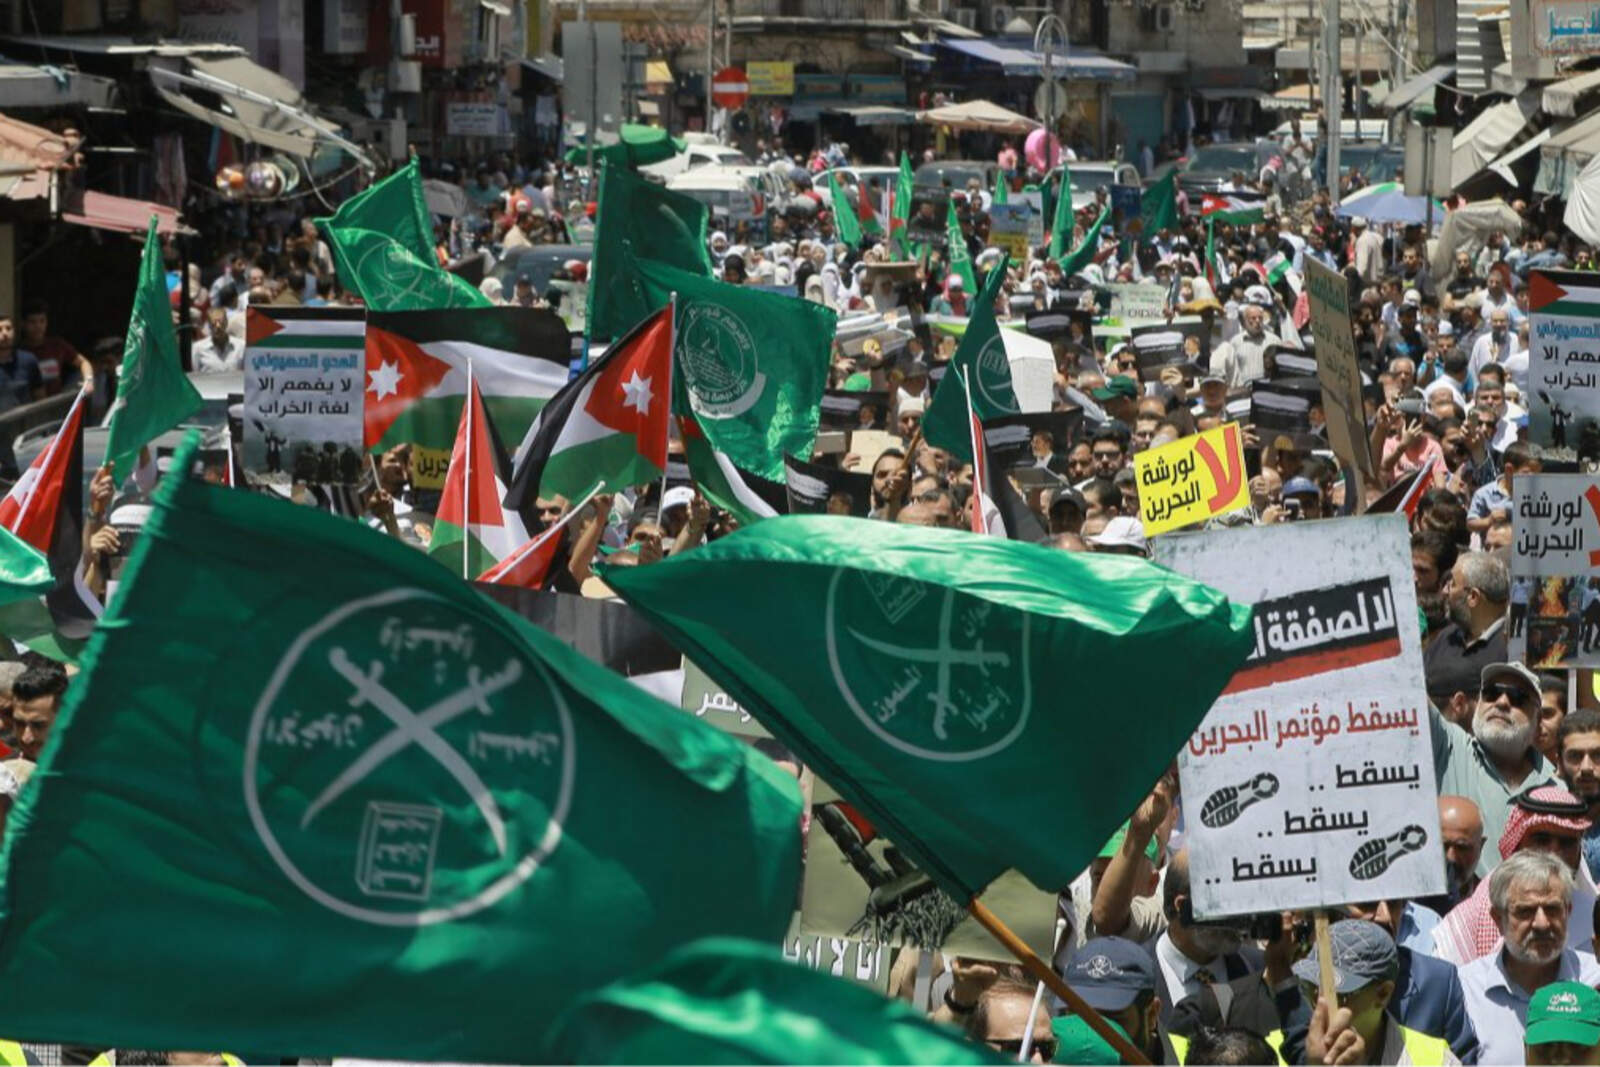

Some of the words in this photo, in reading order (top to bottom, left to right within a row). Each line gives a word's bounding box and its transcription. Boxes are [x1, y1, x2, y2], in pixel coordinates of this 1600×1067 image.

[322, 354, 358, 373] العدو
[281, 378, 334, 395] يفهم
[341, 378, 352, 392] لا
[1543, 371, 1596, 391] الخراب
[258, 400, 312, 418] الخراب
[318, 400, 349, 415] لغة
[1142, 450, 1196, 487] لورشة
[1194, 426, 1242, 514] لا
[1146, 479, 1201, 523] البحرين
[1519, 491, 1582, 527] لورشة
[1517, 528, 1583, 559] البحرين
[1266, 591, 1371, 651] لصفقة
[1373, 587, 1396, 631] لا
[1276, 702, 1341, 749] مؤتمر
[1346, 702, 1419, 737] يسقط
[1336, 760, 1420, 790] يسقط
[1284, 807, 1369, 837] يسقط
[1232, 853, 1317, 883] يسقط
